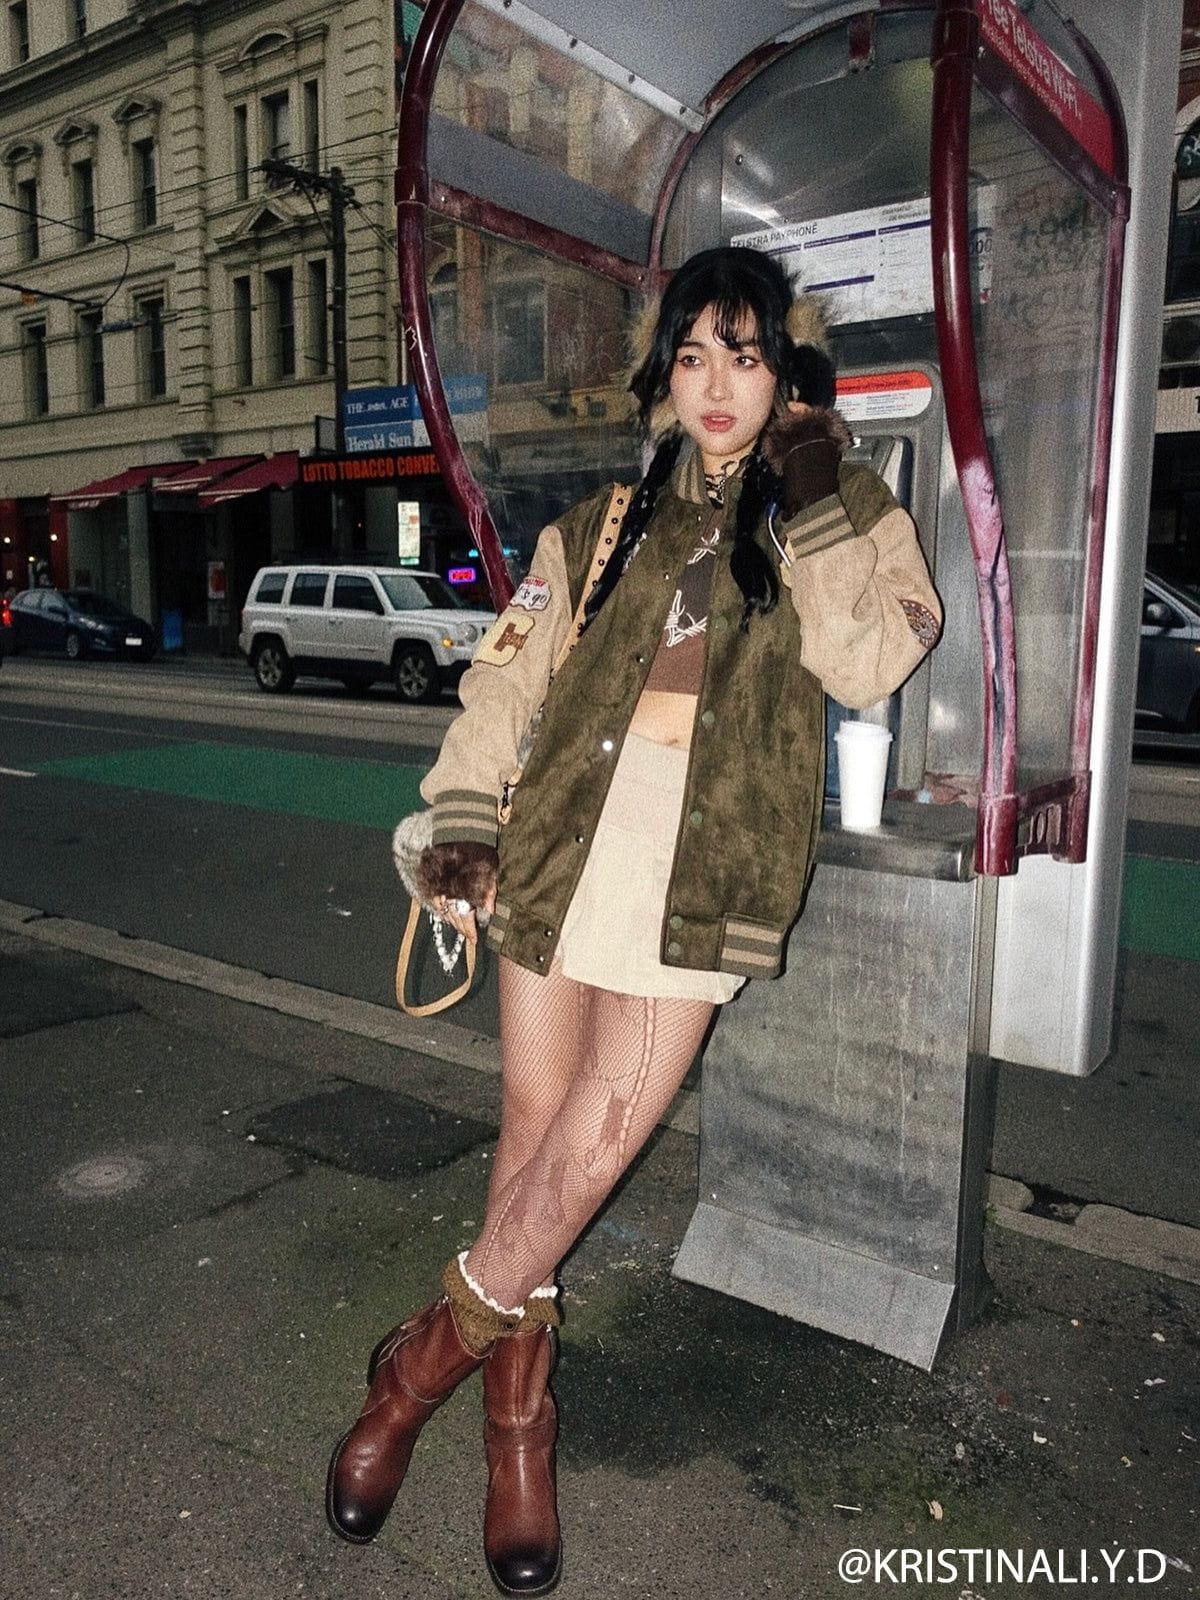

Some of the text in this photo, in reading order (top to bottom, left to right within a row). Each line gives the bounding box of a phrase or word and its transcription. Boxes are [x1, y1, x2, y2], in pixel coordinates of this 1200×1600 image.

[1007, 5, 1051, 87] Telstra
[770, 223, 818, 241] PAYPHONE
[347, 433, 385, 452] Herald
[388, 433, 411, 448] Sun
[303, 453, 440, 482] LOTTO TOBACCO CONVE
